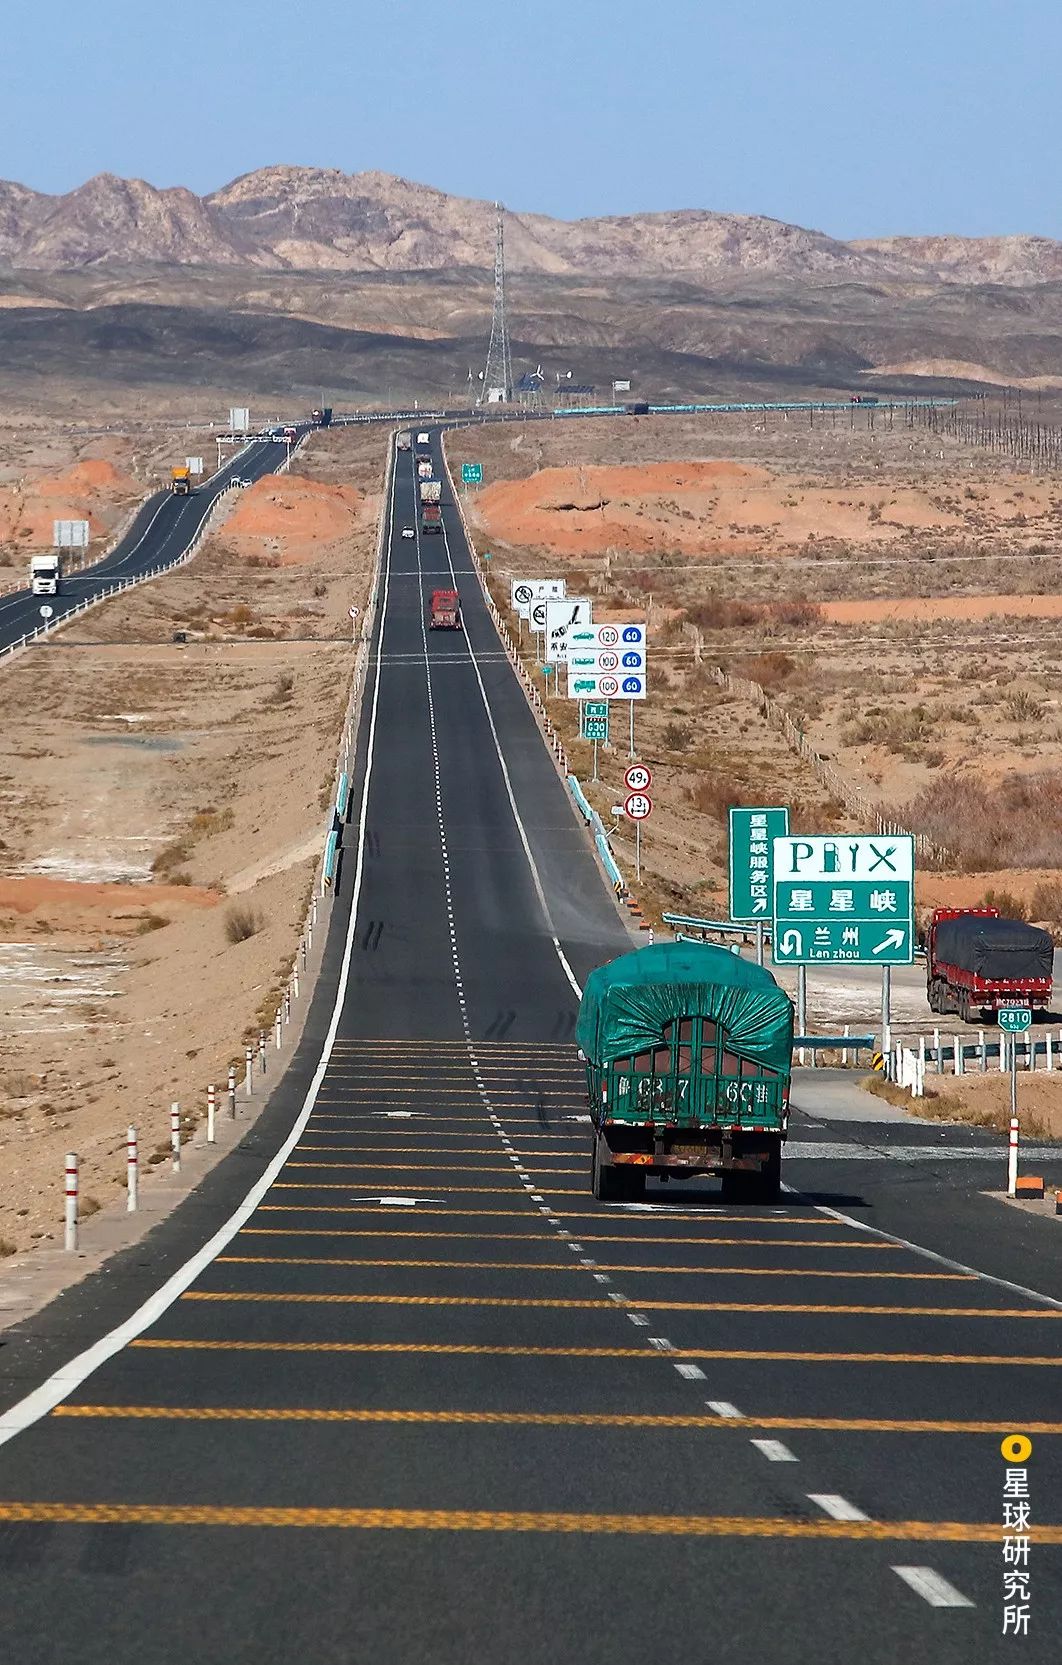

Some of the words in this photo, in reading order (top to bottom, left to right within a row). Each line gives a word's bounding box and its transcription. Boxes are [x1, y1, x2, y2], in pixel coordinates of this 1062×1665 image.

[602, 631, 616, 642] 120
[625, 631, 638, 641] 60
[602, 656, 615, 667] 100
[625, 656, 638, 666] 60
[602, 682, 616, 691] 100
[625, 681, 638, 691] 60
[588, 722, 605, 732] G30
[749, 814, 769, 897] 星星峡服务区
[788, 842, 814, 873] P
[788, 889, 897, 913] 星星峡
[813, 926, 859, 947] 兰州
[1001, 1012, 1029, 1023] 2810
